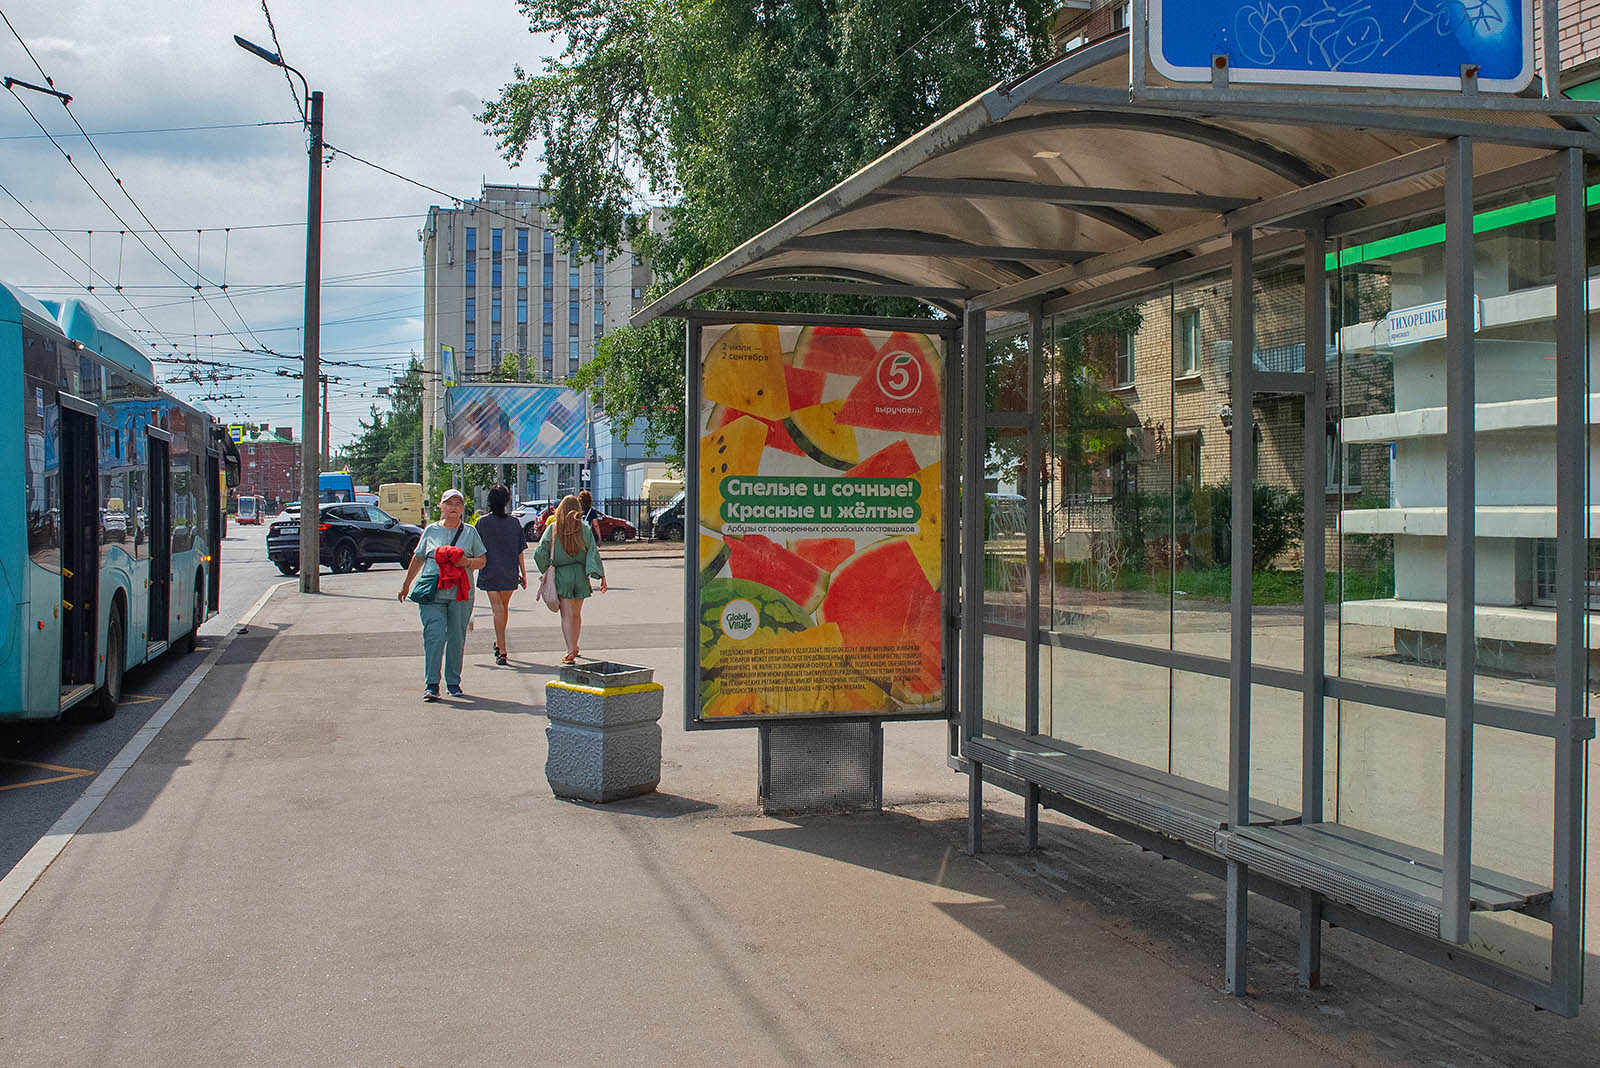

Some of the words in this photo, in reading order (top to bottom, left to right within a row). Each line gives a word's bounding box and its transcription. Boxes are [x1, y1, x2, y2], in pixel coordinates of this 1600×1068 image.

[722, 352, 727, 360] 2
[728, 353, 768, 362] сентября
[888, 355, 912, 390] 5
[727, 479, 809, 496] Спелые
[813, 483, 826, 497] и
[831, 481, 914, 497] сочные!
[727, 503, 815, 522] Красные
[820, 505, 832, 519] и
[837, 501, 915, 519] жёлтые
[727, 525, 757, 533] Арбузы
[768, 526, 819, 534] проверенных
[821, 525, 865, 534] российских
[726, 612, 748, 621] Global
[728, 620, 752, 630] Village
